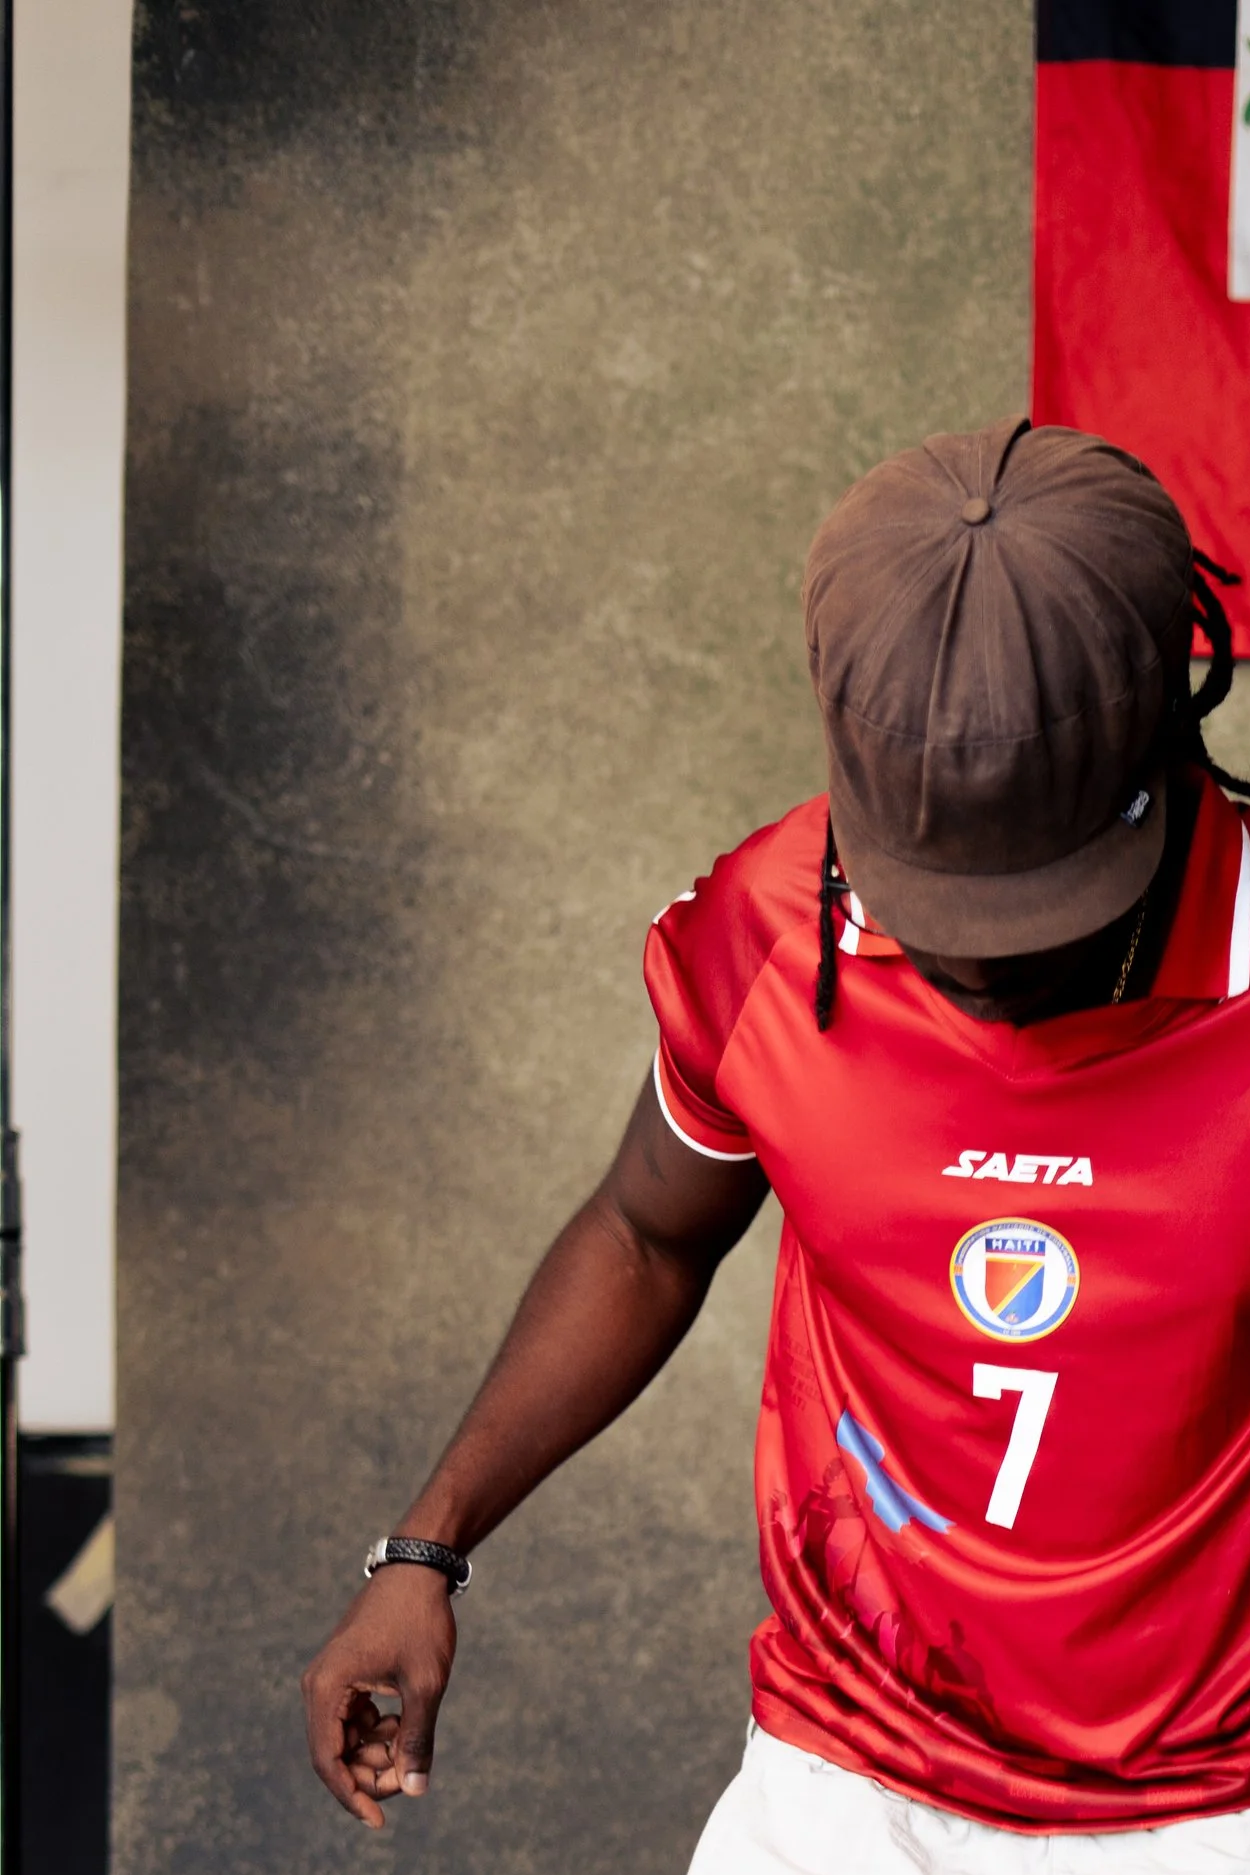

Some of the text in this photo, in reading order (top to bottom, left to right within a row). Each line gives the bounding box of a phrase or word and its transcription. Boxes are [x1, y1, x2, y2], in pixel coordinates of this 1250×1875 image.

[941, 1149, 1094, 1187] SAETA
[991, 1239, 1040, 1252] HAITI
[972, 1362, 1060, 1531] 7
